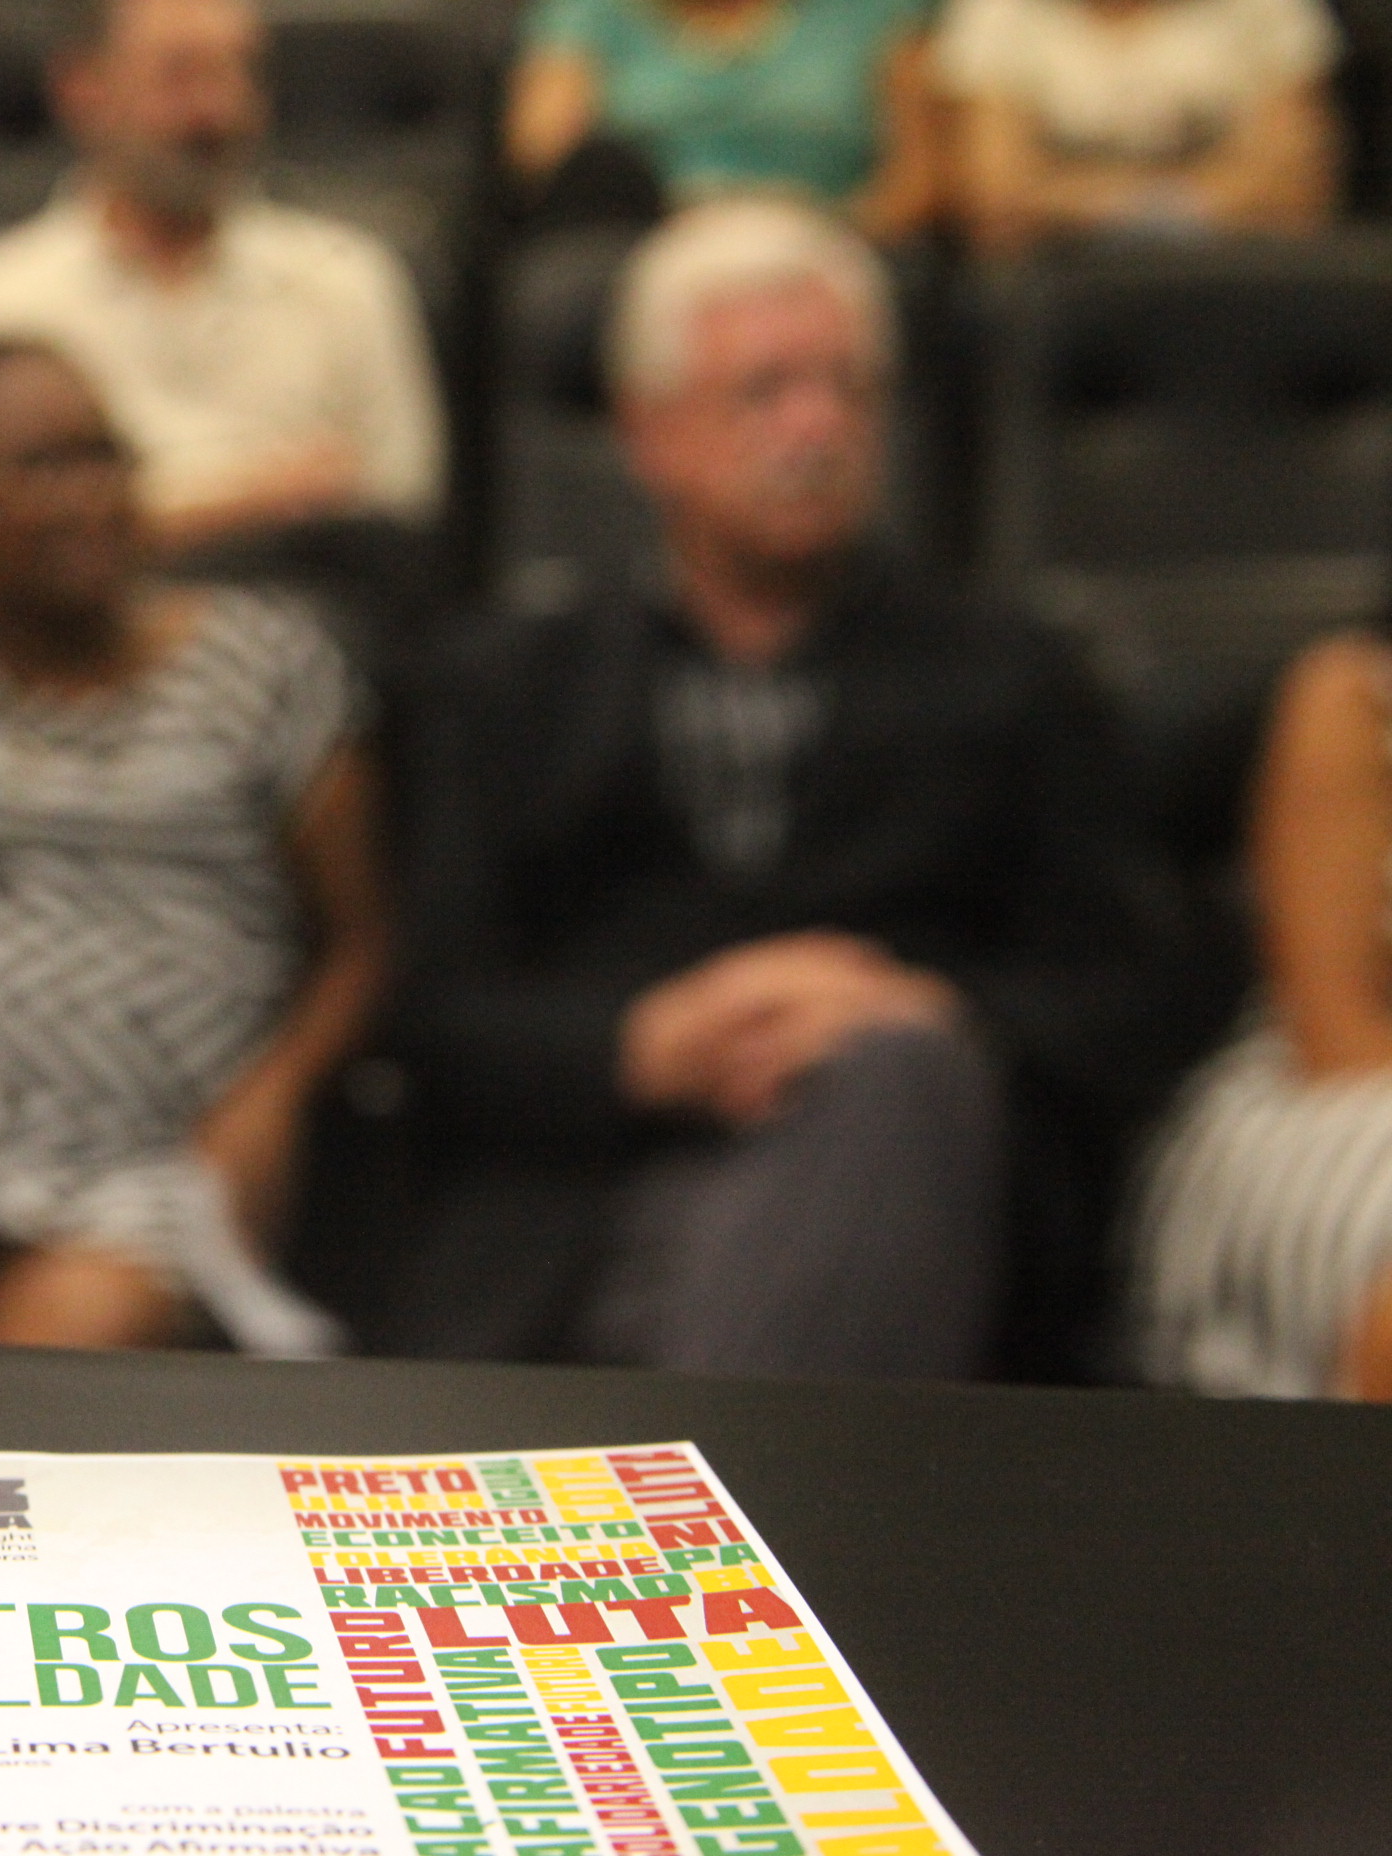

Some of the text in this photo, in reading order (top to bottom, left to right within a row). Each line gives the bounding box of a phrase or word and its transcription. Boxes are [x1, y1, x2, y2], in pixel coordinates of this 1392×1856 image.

[280, 1469, 478, 1495] PRETO
[294, 1509, 550, 1529] MOVIMENTO
[313, 1556, 665, 1584] LIBERDADE
[320, 1573, 694, 1609] RACISMO
[416, 1586, 806, 1649] LUTA
[329, 1611, 457, 1759] FUTURO
[519, 1646, 609, 1712] FUTURO
[126, 1719, 343, 1736] Apresenta:
[130, 1738, 351, 1759] Bertulio
[432, 1647, 603, 1856] AFIRMATIVA
[57, 1818, 377, 1840] Discriminação
